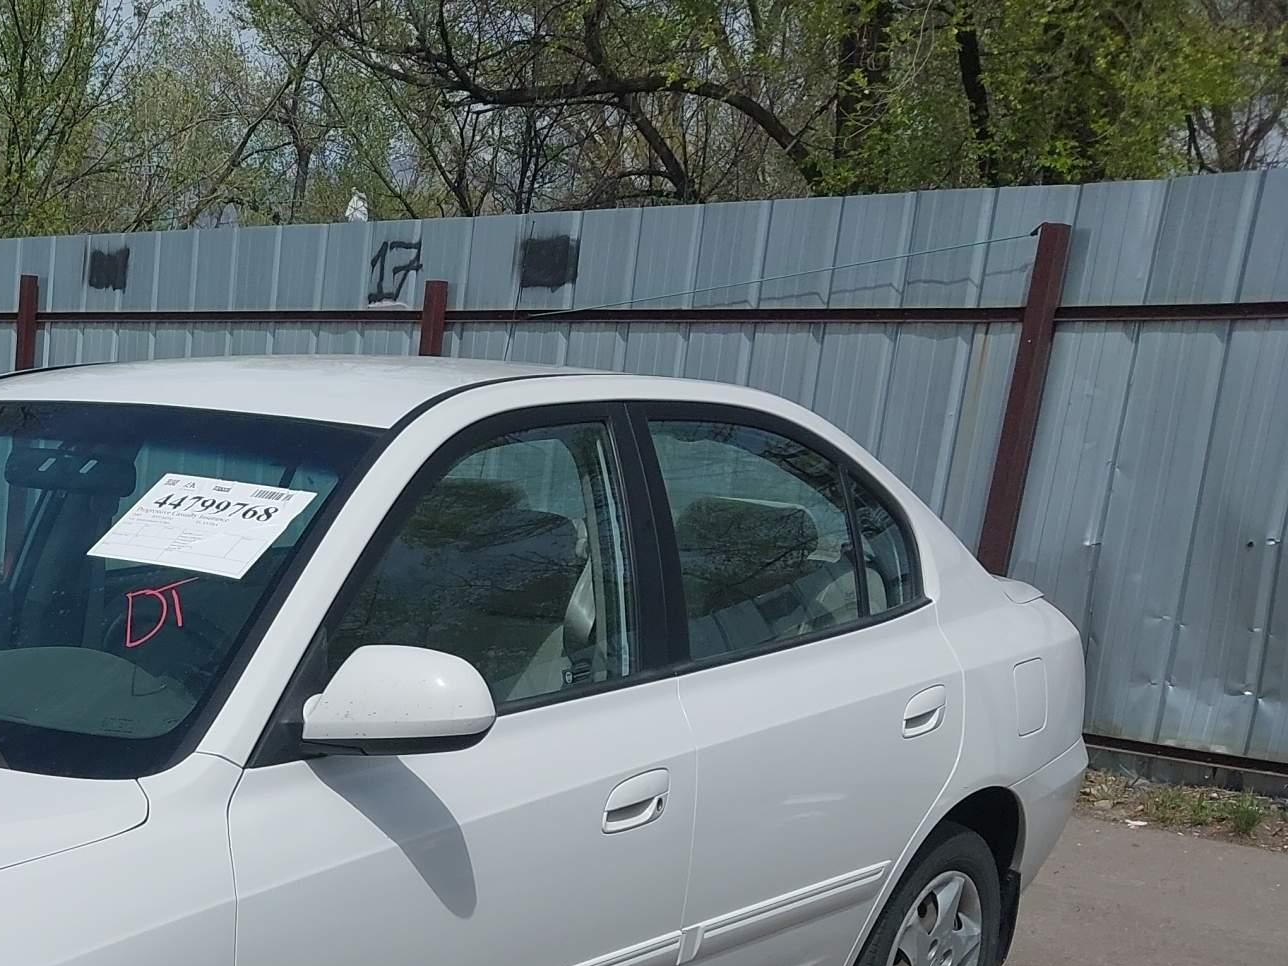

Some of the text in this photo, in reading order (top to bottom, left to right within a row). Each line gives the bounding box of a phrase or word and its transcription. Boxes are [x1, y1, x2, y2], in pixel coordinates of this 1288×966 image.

[367, 241, 423, 304] 17
[154, 493, 279, 522] 44799768
[126, 578, 199, 648] DT
